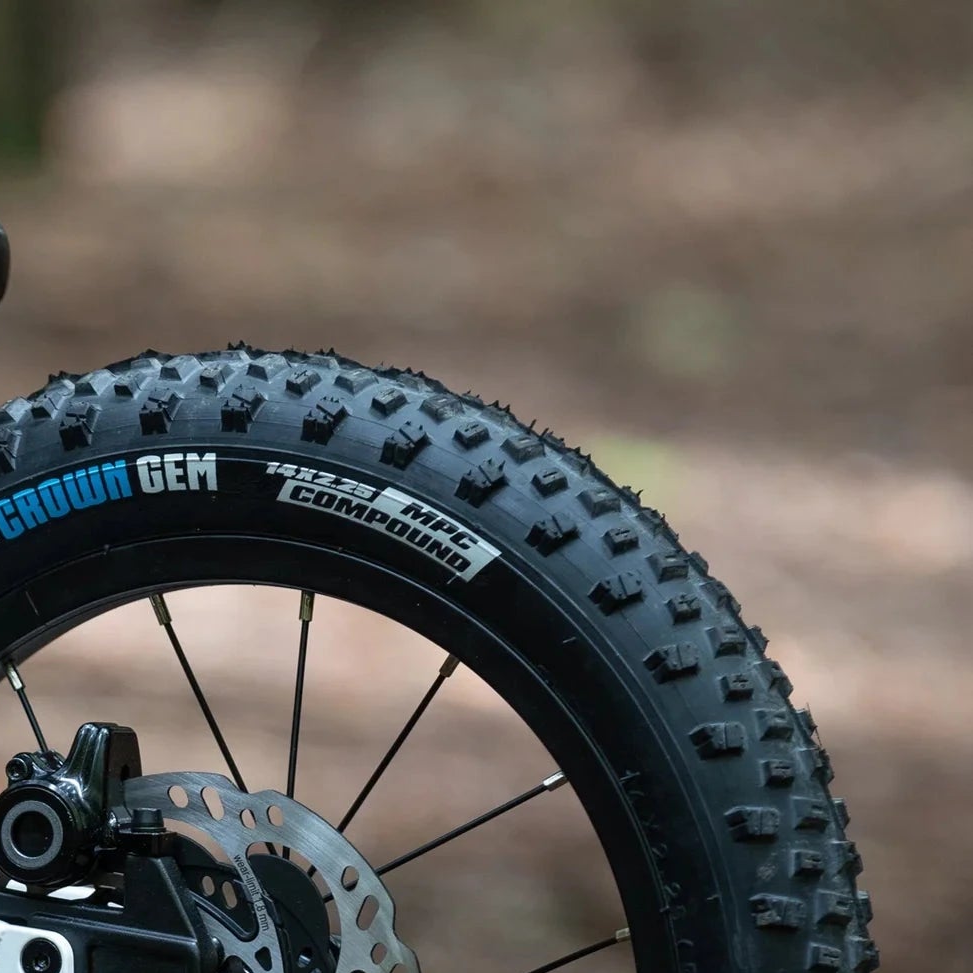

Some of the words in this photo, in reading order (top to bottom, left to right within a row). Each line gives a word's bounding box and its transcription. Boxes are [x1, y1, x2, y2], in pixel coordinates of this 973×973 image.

[136, 452, 218, 494] GEM
[289, 484, 471, 573] COMPOUND
[400, 502, 478, 550] MPC
[233, 854, 259, 897] wear-limit
